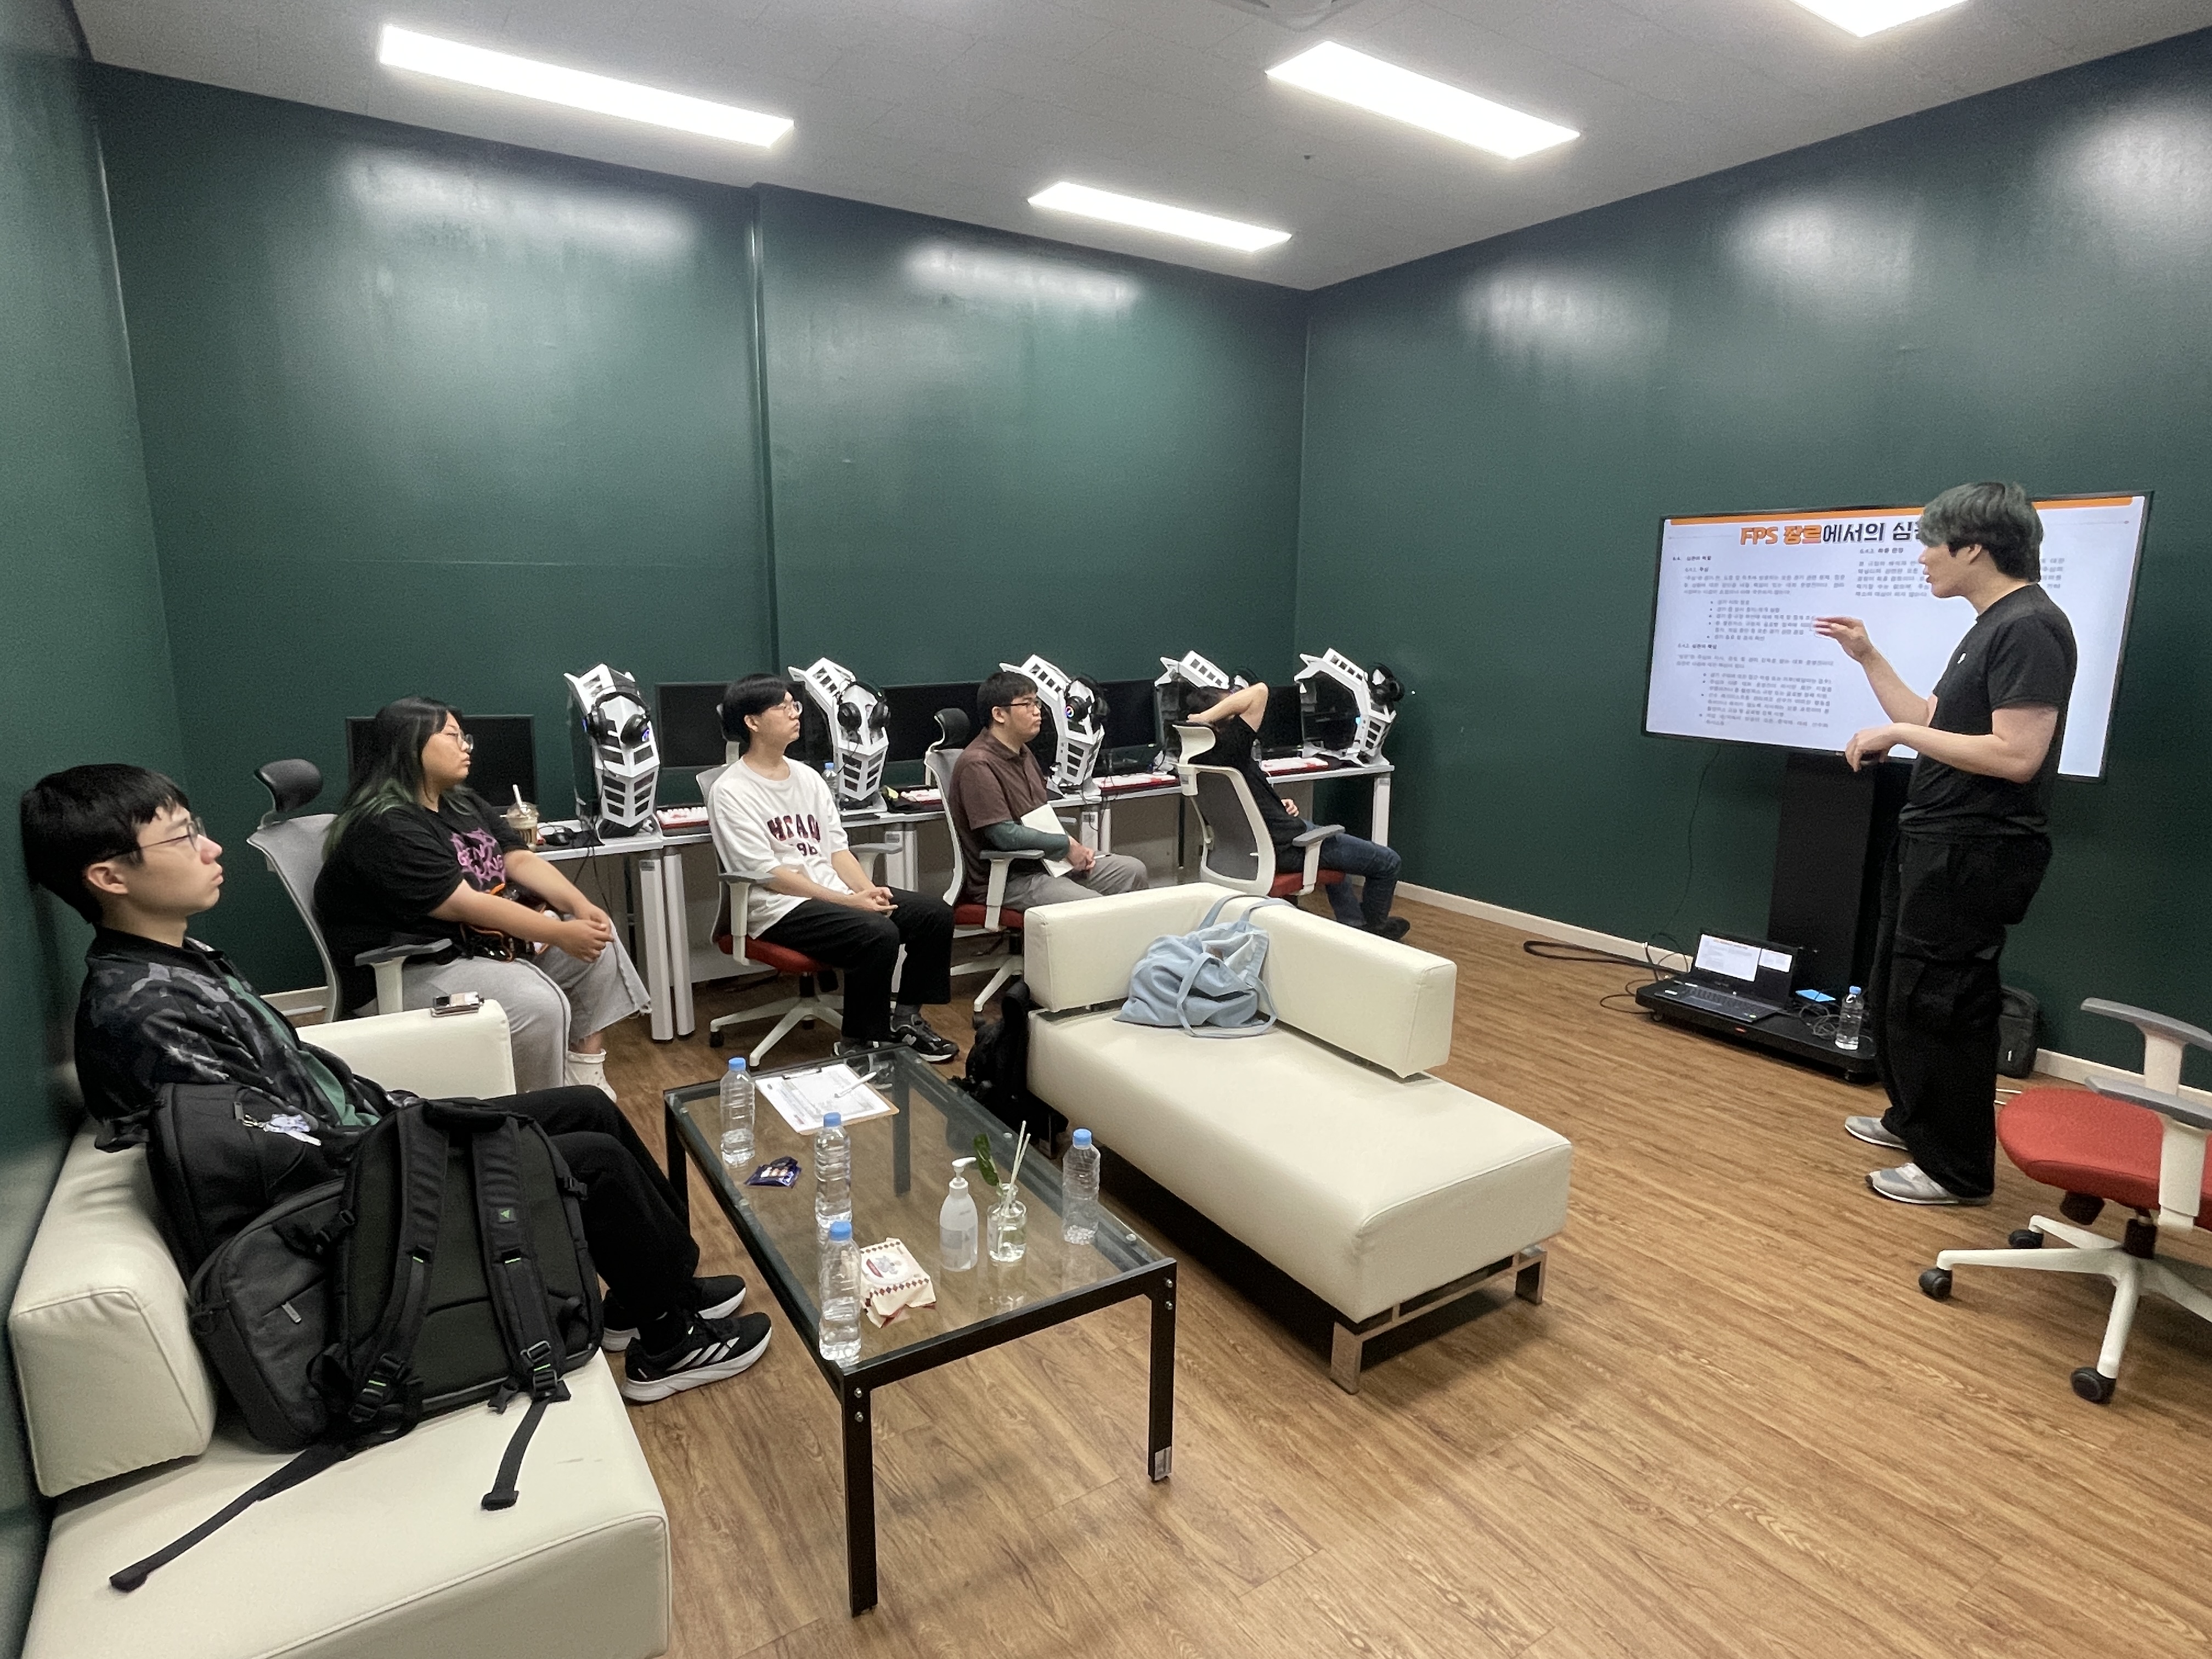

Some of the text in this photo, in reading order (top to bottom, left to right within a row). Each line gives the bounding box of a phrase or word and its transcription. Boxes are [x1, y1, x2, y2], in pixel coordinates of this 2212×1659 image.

[1740, 521, 1921, 545] FPS 장르에서의 심
